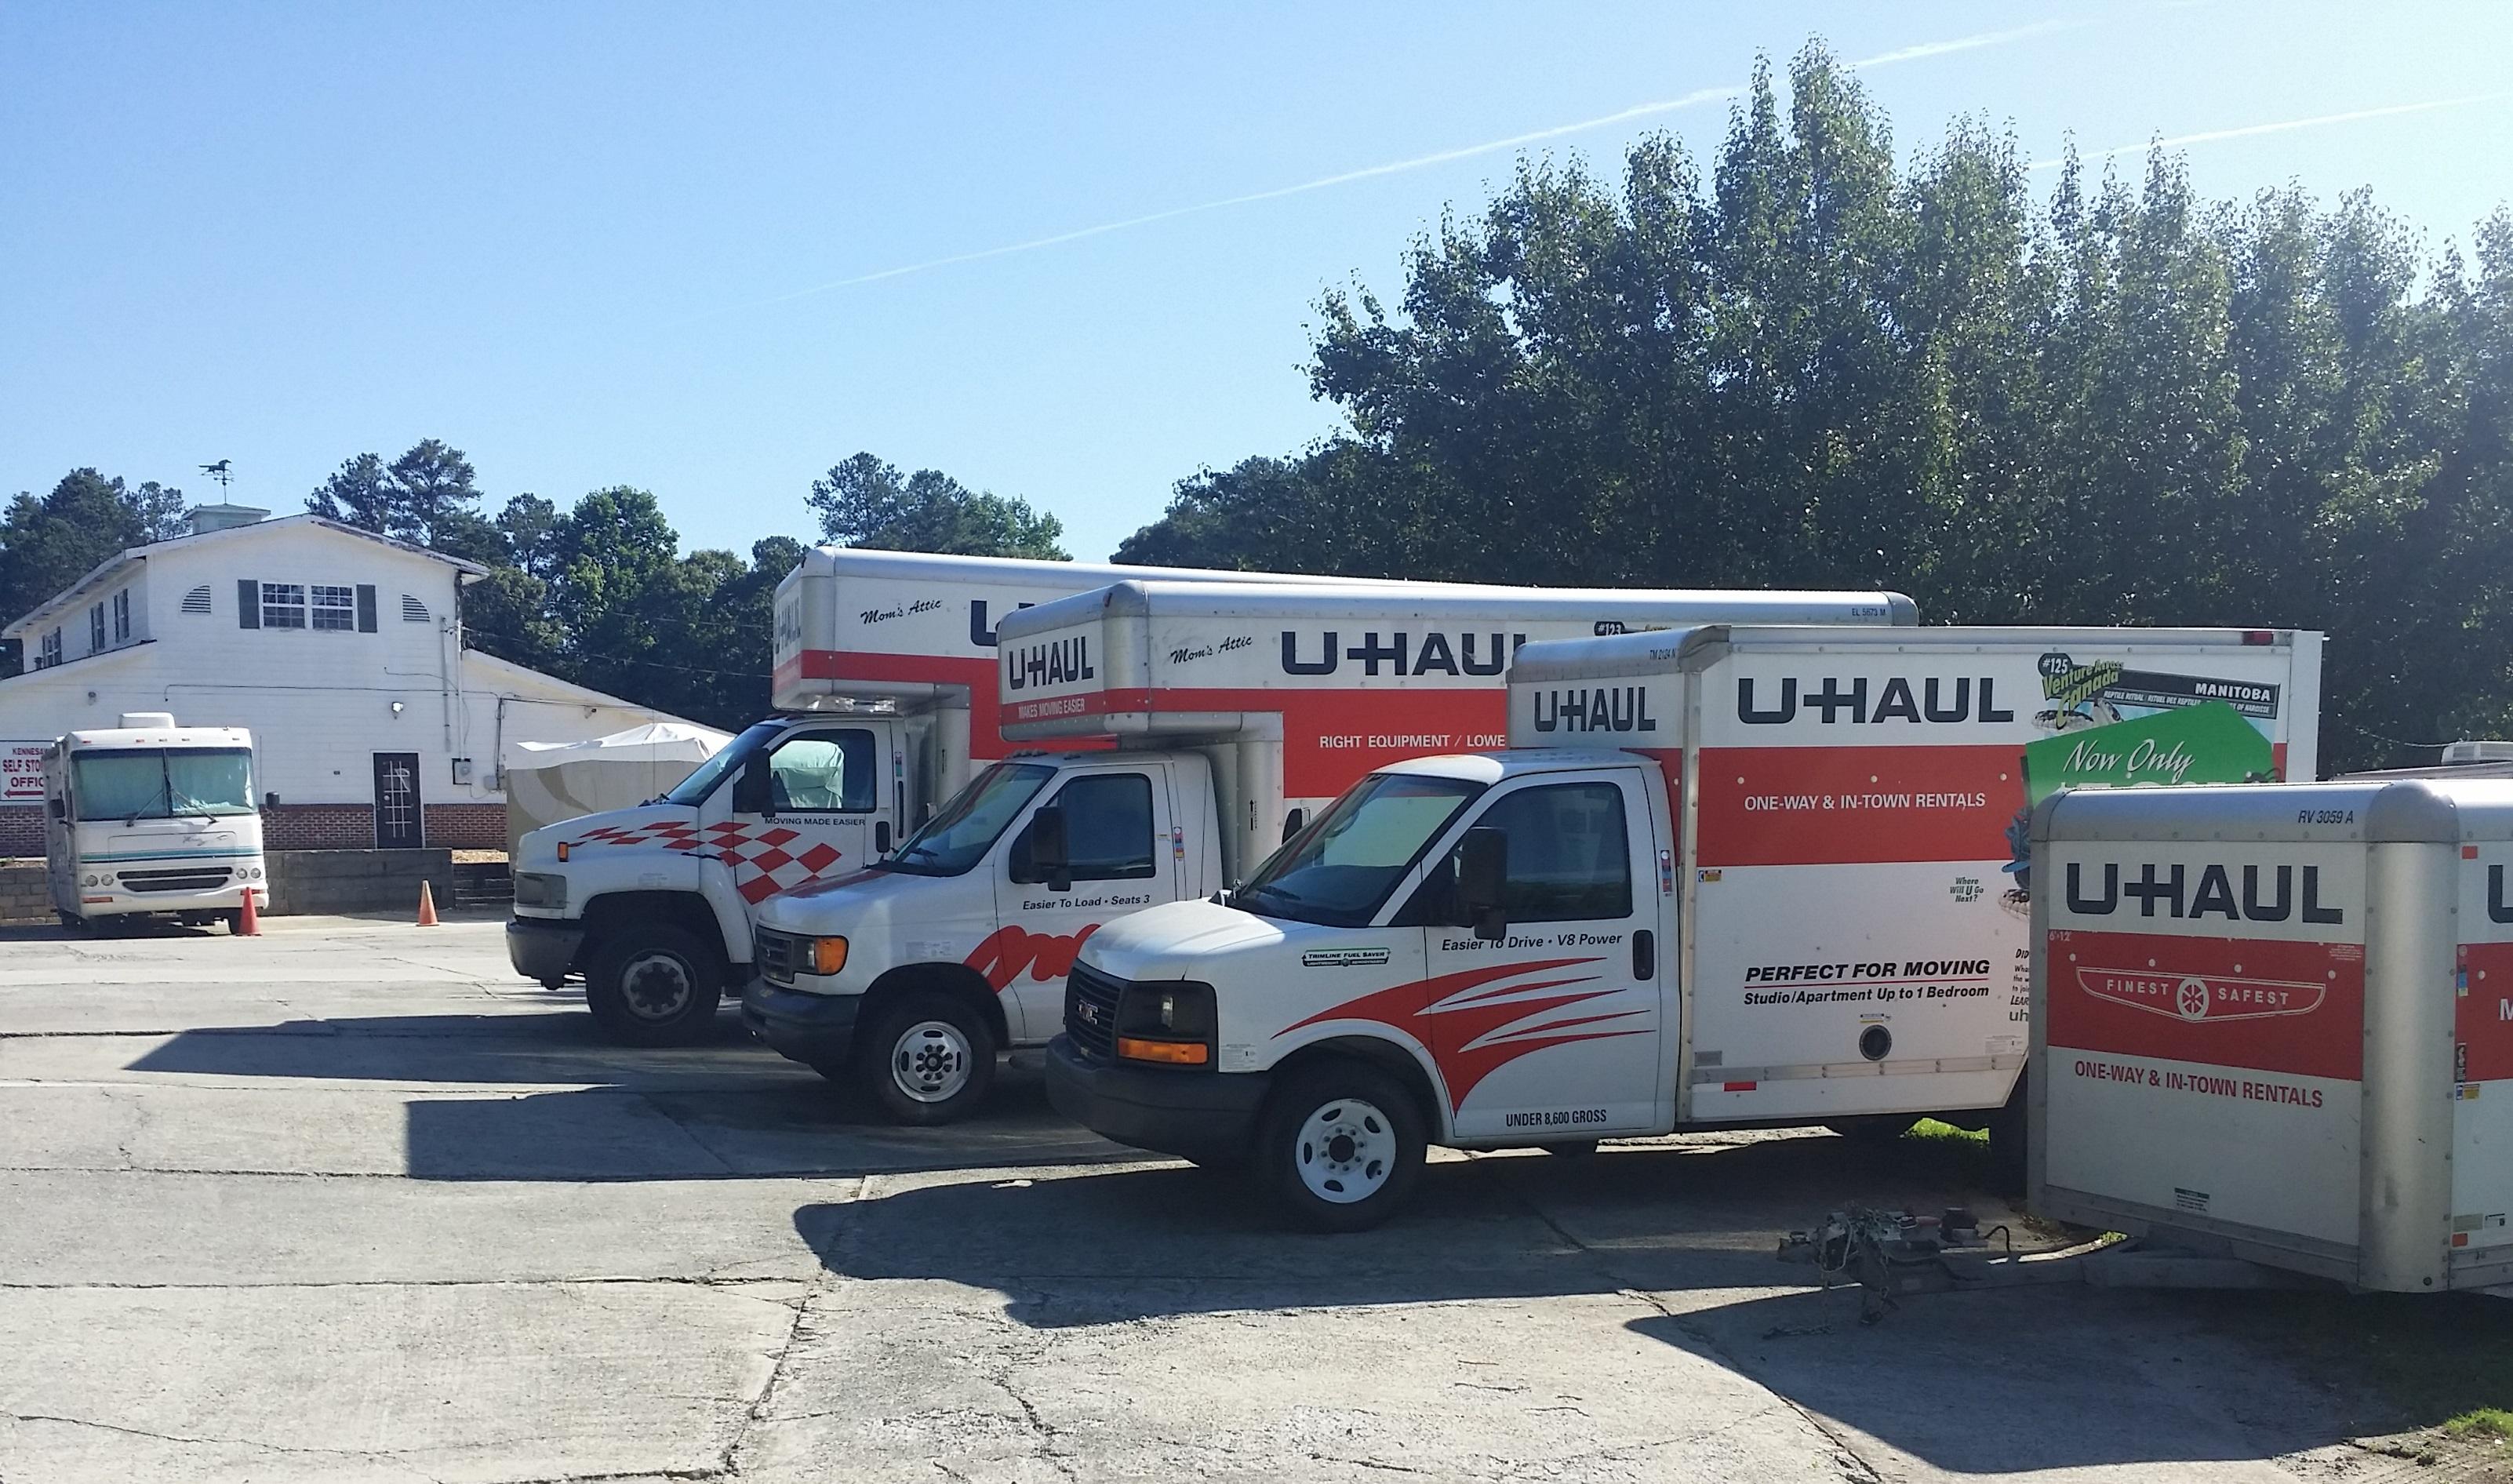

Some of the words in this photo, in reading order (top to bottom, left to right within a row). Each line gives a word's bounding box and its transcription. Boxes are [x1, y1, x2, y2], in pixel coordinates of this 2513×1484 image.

[860, 607, 903, 625] Mom's
[907, 599, 942, 616] Attic
[1170, 645, 1213, 664] Mom's
[1218, 636, 1253, 654] Attic
[1009, 636, 1094, 690] U-HAUL
[2042, 658, 2068, 674] #125
[2042, 664, 2094, 700] Venture
[2195, 682, 2271, 702] MANITOBA
[1018, 704, 1038, 718] MAKES
[1039, 700, 1063, 716] MOVING
[1064, 698, 1085, 713] EASIER
[1534, 686, 1656, 732] U-HAUL
[1738, 678, 2014, 724] U-HAUL
[2056, 669, 2118, 730] Canada
[1319, 736, 1362, 748] RIGHT
[1368, 734, 1450, 747] EQUIPMENT
[3, 759, 22, 772] SELF
[2063, 740, 2122, 773] Now
[2126, 738, 2196, 785] Only
[1744, 795, 1819, 811] ONE-WAY
[1822, 795, 1835, 809] &
[1841, 795, 1911, 809] IN-TOWN
[1916, 792, 1986, 809] RENTALS
[2298, 810, 2315, 824] RV
[2316, 810, 2343, 824] 3059
[2344, 810, 2354, 824] A
[1023, 901, 1056, 910] Easier
[1060, 899, 1072, 907] To
[1075, 897, 1102, 907] Load
[1111, 896, 1140, 905] Seats
[1143, 894, 1151, 904] 3
[2067, 863, 2343, 924] U-HAUL
[1442, 939, 1485, 951] Easier
[1507, 936, 1544, 948] Drive
[1557, 934, 1575, 946] V8
[1579, 932, 1623, 945] Power
[1745, 964, 1848, 981] PERFECT
[1852, 962, 1897, 977] FOR
[1903, 960, 1990, 977] MOVING
[1744, 990, 1872, 1005] Studio/Apartment
[1877, 988, 1895, 1001] Up
[1899, 988, 1913, 998] to
[1917, 988, 1922, 998] 1
[1927, 986, 1989, 998] Bedroom
[2107, 980, 2169, 995] FINEST
[2218, 988, 2289, 1005] SAFEST
[2075, 1060, 2145, 1082] ONE-WAY
[2148, 1071, 2161, 1086] &
[2166, 1072, 2237, 1097] IN-TOWN
[2242, 1082, 2323, 1108] RENTALS
[1506, 1113, 1542, 1126] UNDER
[1544, 1112, 1569, 1126] 8,600
[1572, 1109, 1606, 1123] GROSS
